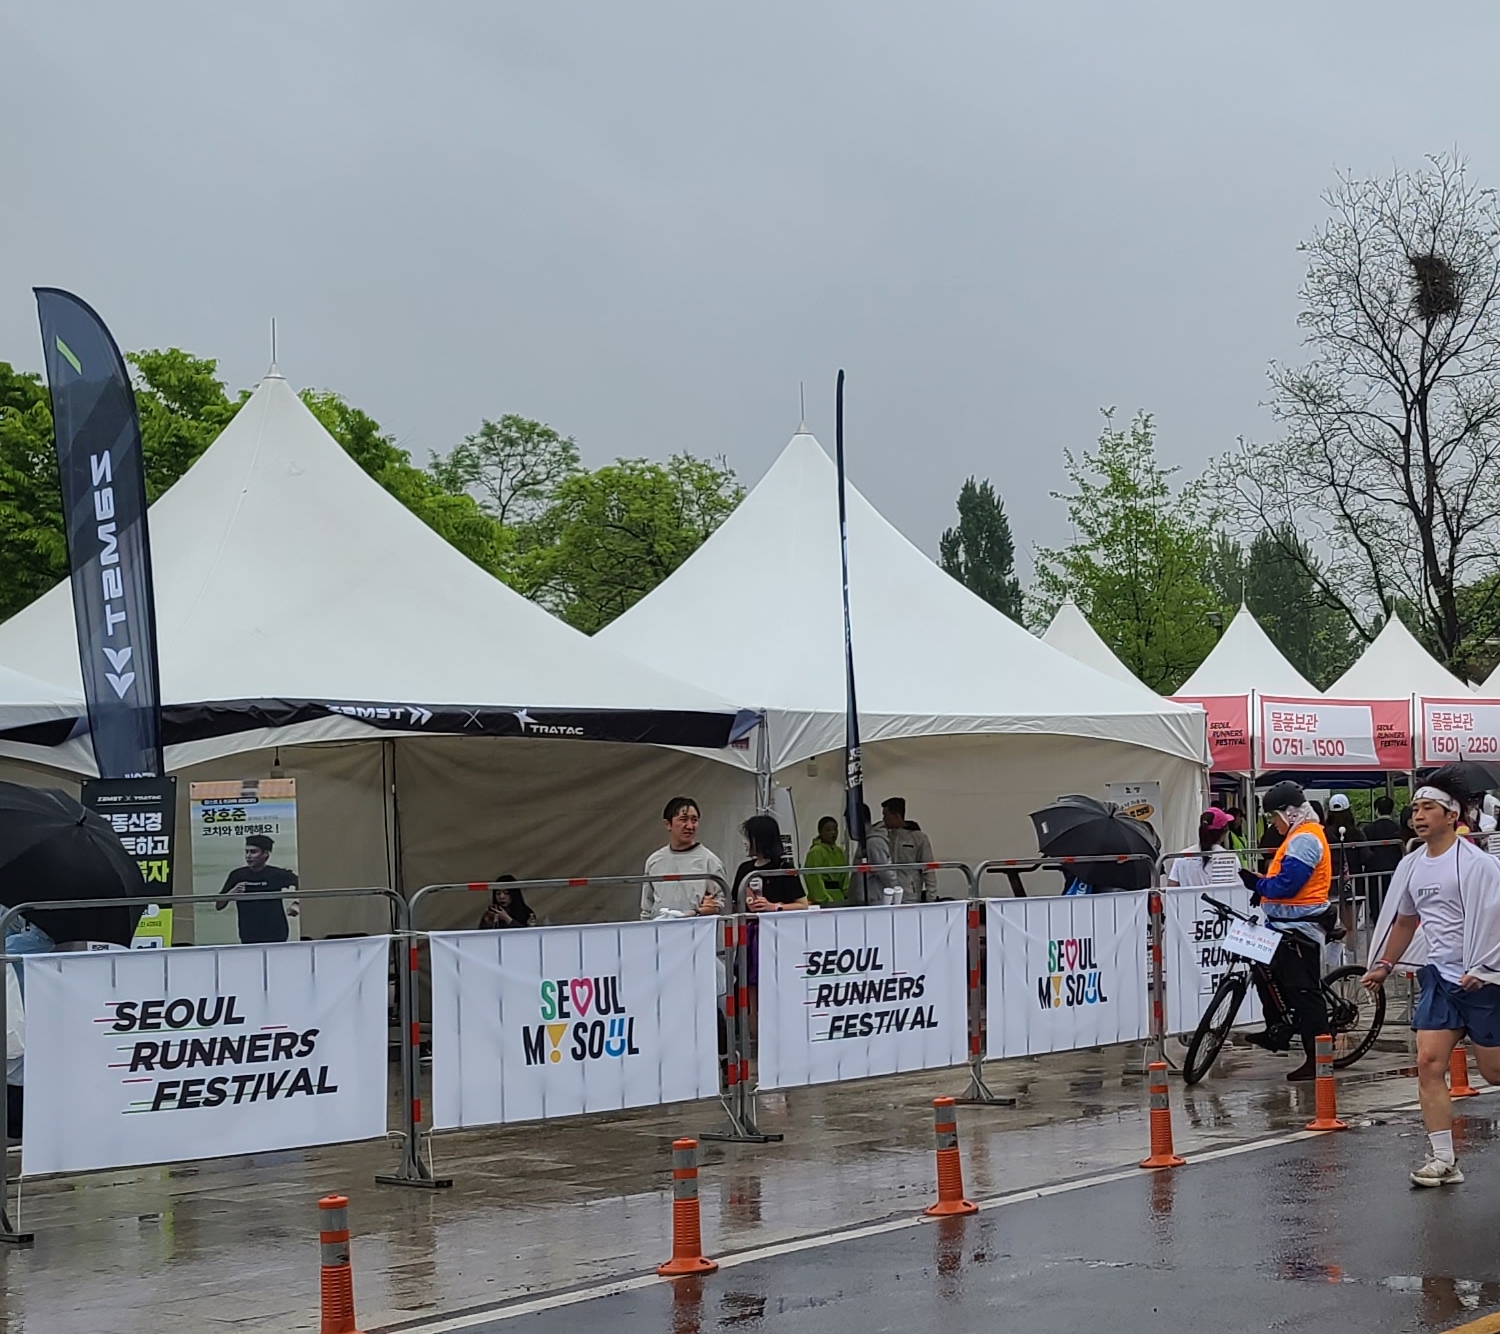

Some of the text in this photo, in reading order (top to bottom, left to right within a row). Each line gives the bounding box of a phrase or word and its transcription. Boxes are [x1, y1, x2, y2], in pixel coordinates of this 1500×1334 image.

[530, 724, 584, 735] TRATAC
[1212, 730, 1243, 738] RUNNERS
[1271, 712, 1318, 732] 물품보관
[1431, 712, 1474, 731] 물품보관
[1215, 738, 1246, 746] FESTIVAL
[99, 812, 163, 833] 동신경
[201, 807, 246, 824] 장호준
[202, 826, 232, 837] 코치와
[806, 947, 883, 976] SEOUL
[816, 974, 925, 1009] RUNNERS
[1065, 971, 1107, 1007] SOUL
[112, 996, 245, 1032] SEOUL
[828, 1005, 939, 1040] FESTIVAL
[129, 1028, 319, 1072] RUNNERS
[571, 1017, 640, 1061] SOUL
[151, 1065, 338, 1111] FESTIVAL
